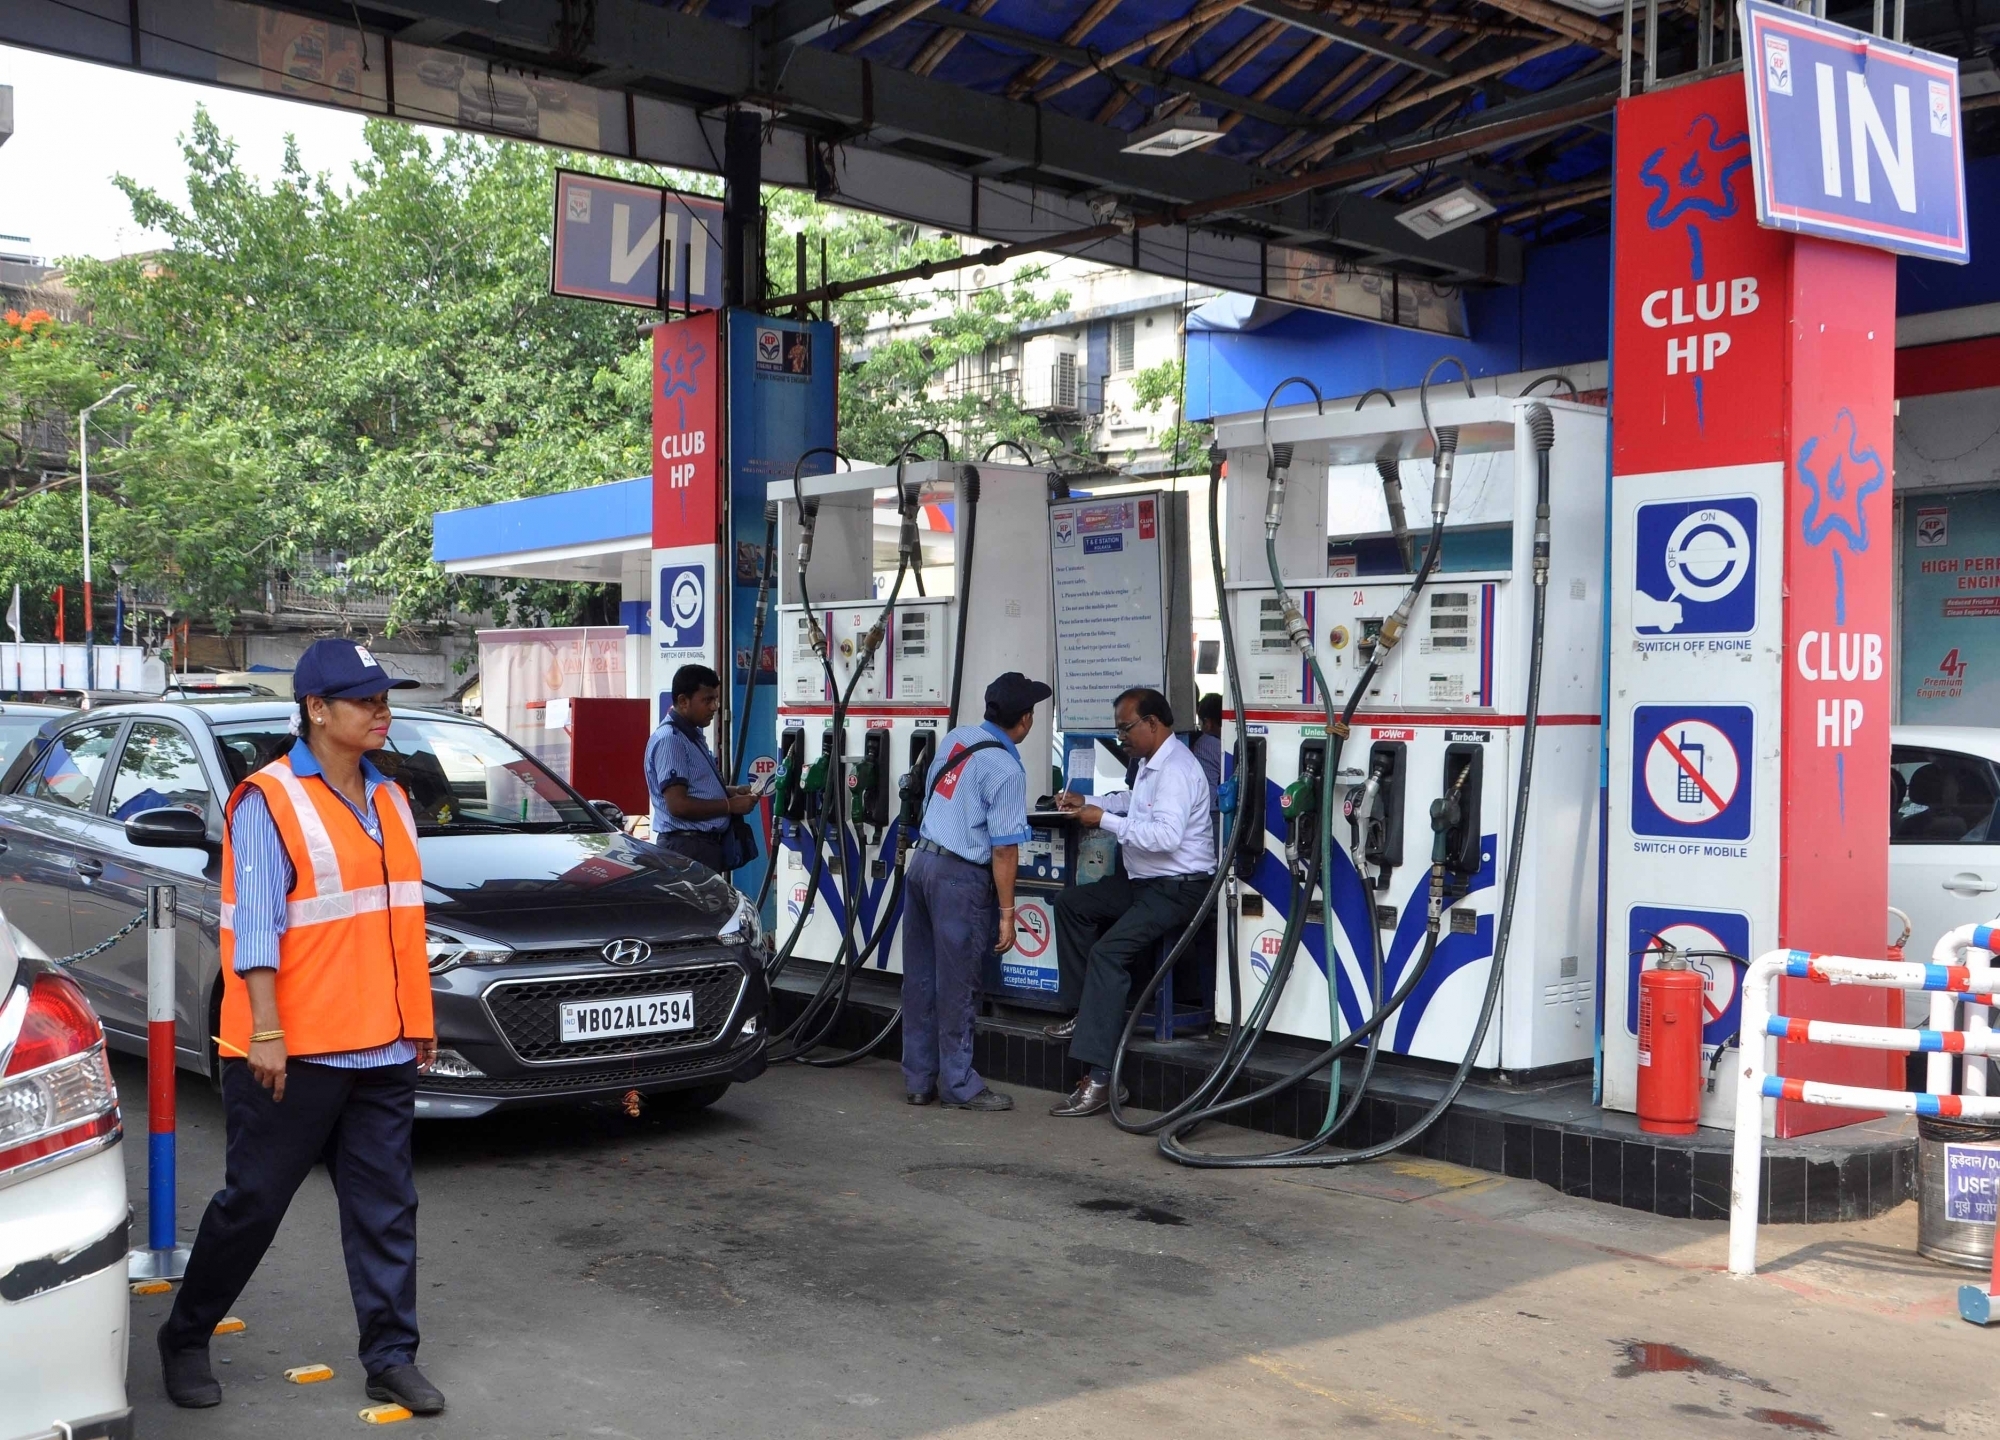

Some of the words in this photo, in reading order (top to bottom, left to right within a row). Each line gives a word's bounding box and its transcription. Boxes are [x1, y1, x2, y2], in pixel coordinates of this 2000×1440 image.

[1774, 58, 1784, 68] HP
[1815, 62, 1916, 214] IN
[1641, 276, 1760, 330] CLUB
[764, 336, 776, 344] HP
[1666, 331, 1731, 377] HP
[661, 431, 705, 460] CLUB
[670, 463, 695, 489] HP
[1701, 512, 1716, 523] ON
[1925, 521, 1940, 530] HP
[1668, 546, 1677, 569] OFF
[1921, 559, 1958, 573] HIGH
[1353, 591, 1364, 606] 2A
[854, 615, 861, 627] 2B
[1637, 641, 1680, 652] SWITCH
[1683, 641, 1705, 651] OFF
[1708, 640, 1752, 651] ENGINE
[687, 651, 704, 659] ENGINE
[1797, 630, 1884, 682] CLUB
[1939, 647, 1967, 678] 4T
[1924, 678, 1963, 687] Premium
[1393, 694, 1397, 702] 7
[1465, 695, 1470, 703] 8
[1917, 689, 1947, 699] Engine
[1949, 688, 1962, 698] Oil
[1816, 698, 1864, 748] HP
[1245, 726, 1265, 734] iesel
[756, 762, 774, 773] HP
[1633, 842, 1676, 854] SWITCH
[1678, 845, 1701, 855] OFF
[1704, 846, 1747, 858] MOBILE
[1003, 965, 1027, 975] PAYBACK
[1027, 969, 1039, 977] card
[1004, 976, 1026, 984] accepted
[577, 999, 691, 1034] WB02AL2594
[1958, 1175, 1990, 1195] USE
